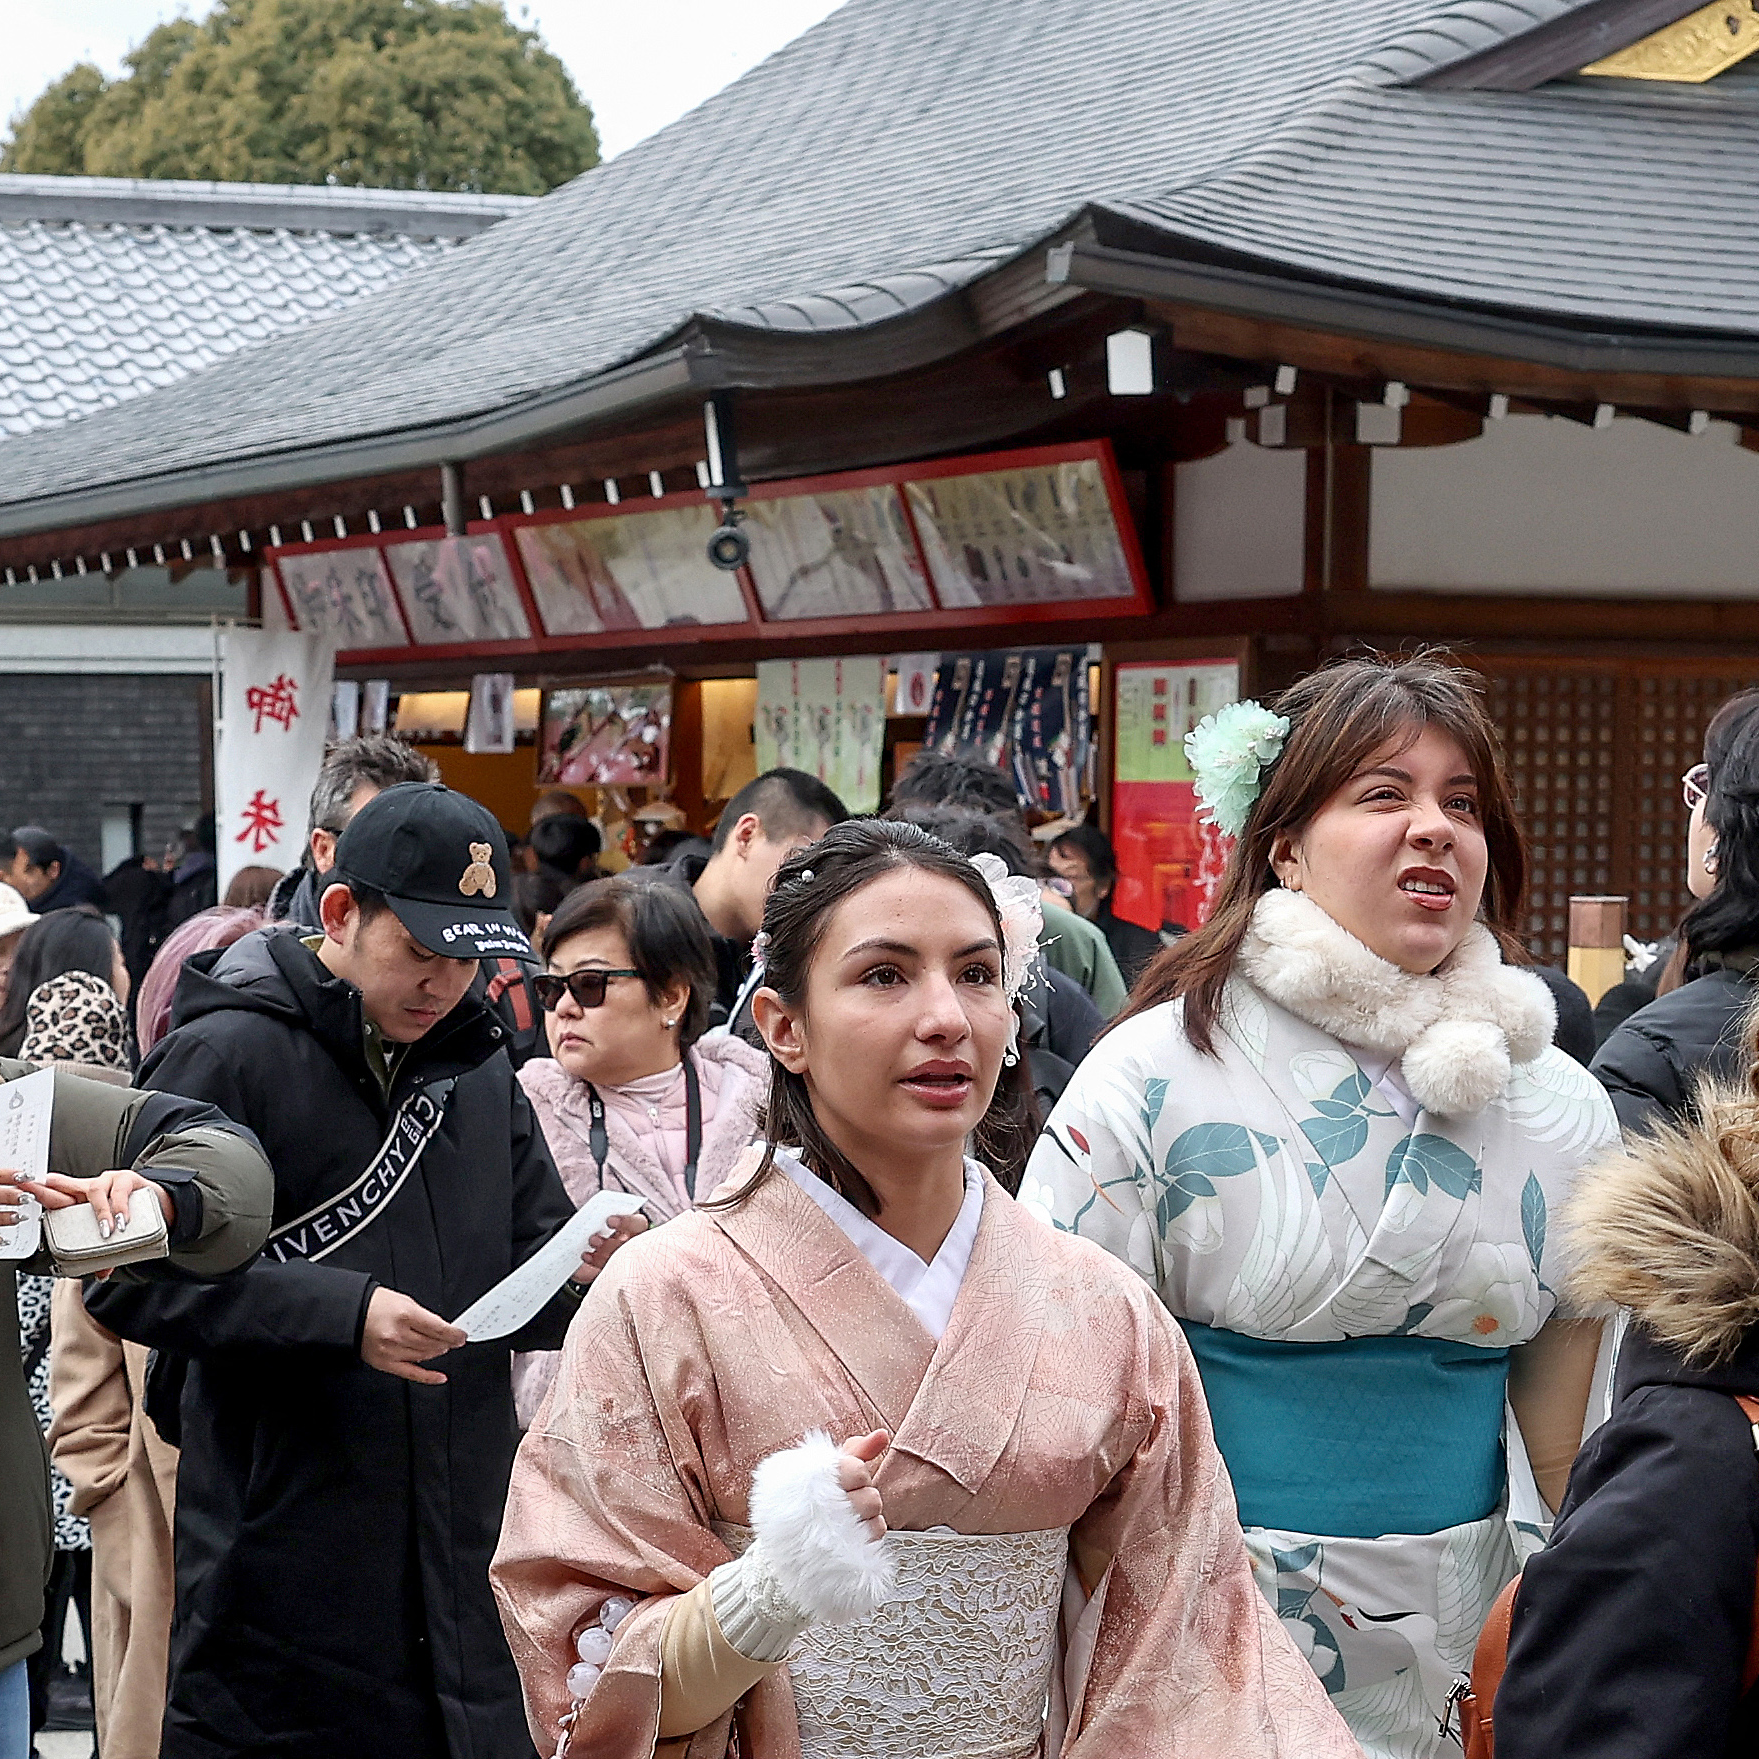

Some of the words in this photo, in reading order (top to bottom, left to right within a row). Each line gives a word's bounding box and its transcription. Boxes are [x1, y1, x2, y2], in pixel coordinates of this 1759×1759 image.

[442, 922, 485, 943] BEAR
[484, 922, 501, 935] IN
[261, 1137, 407, 1264] IVENCHY
